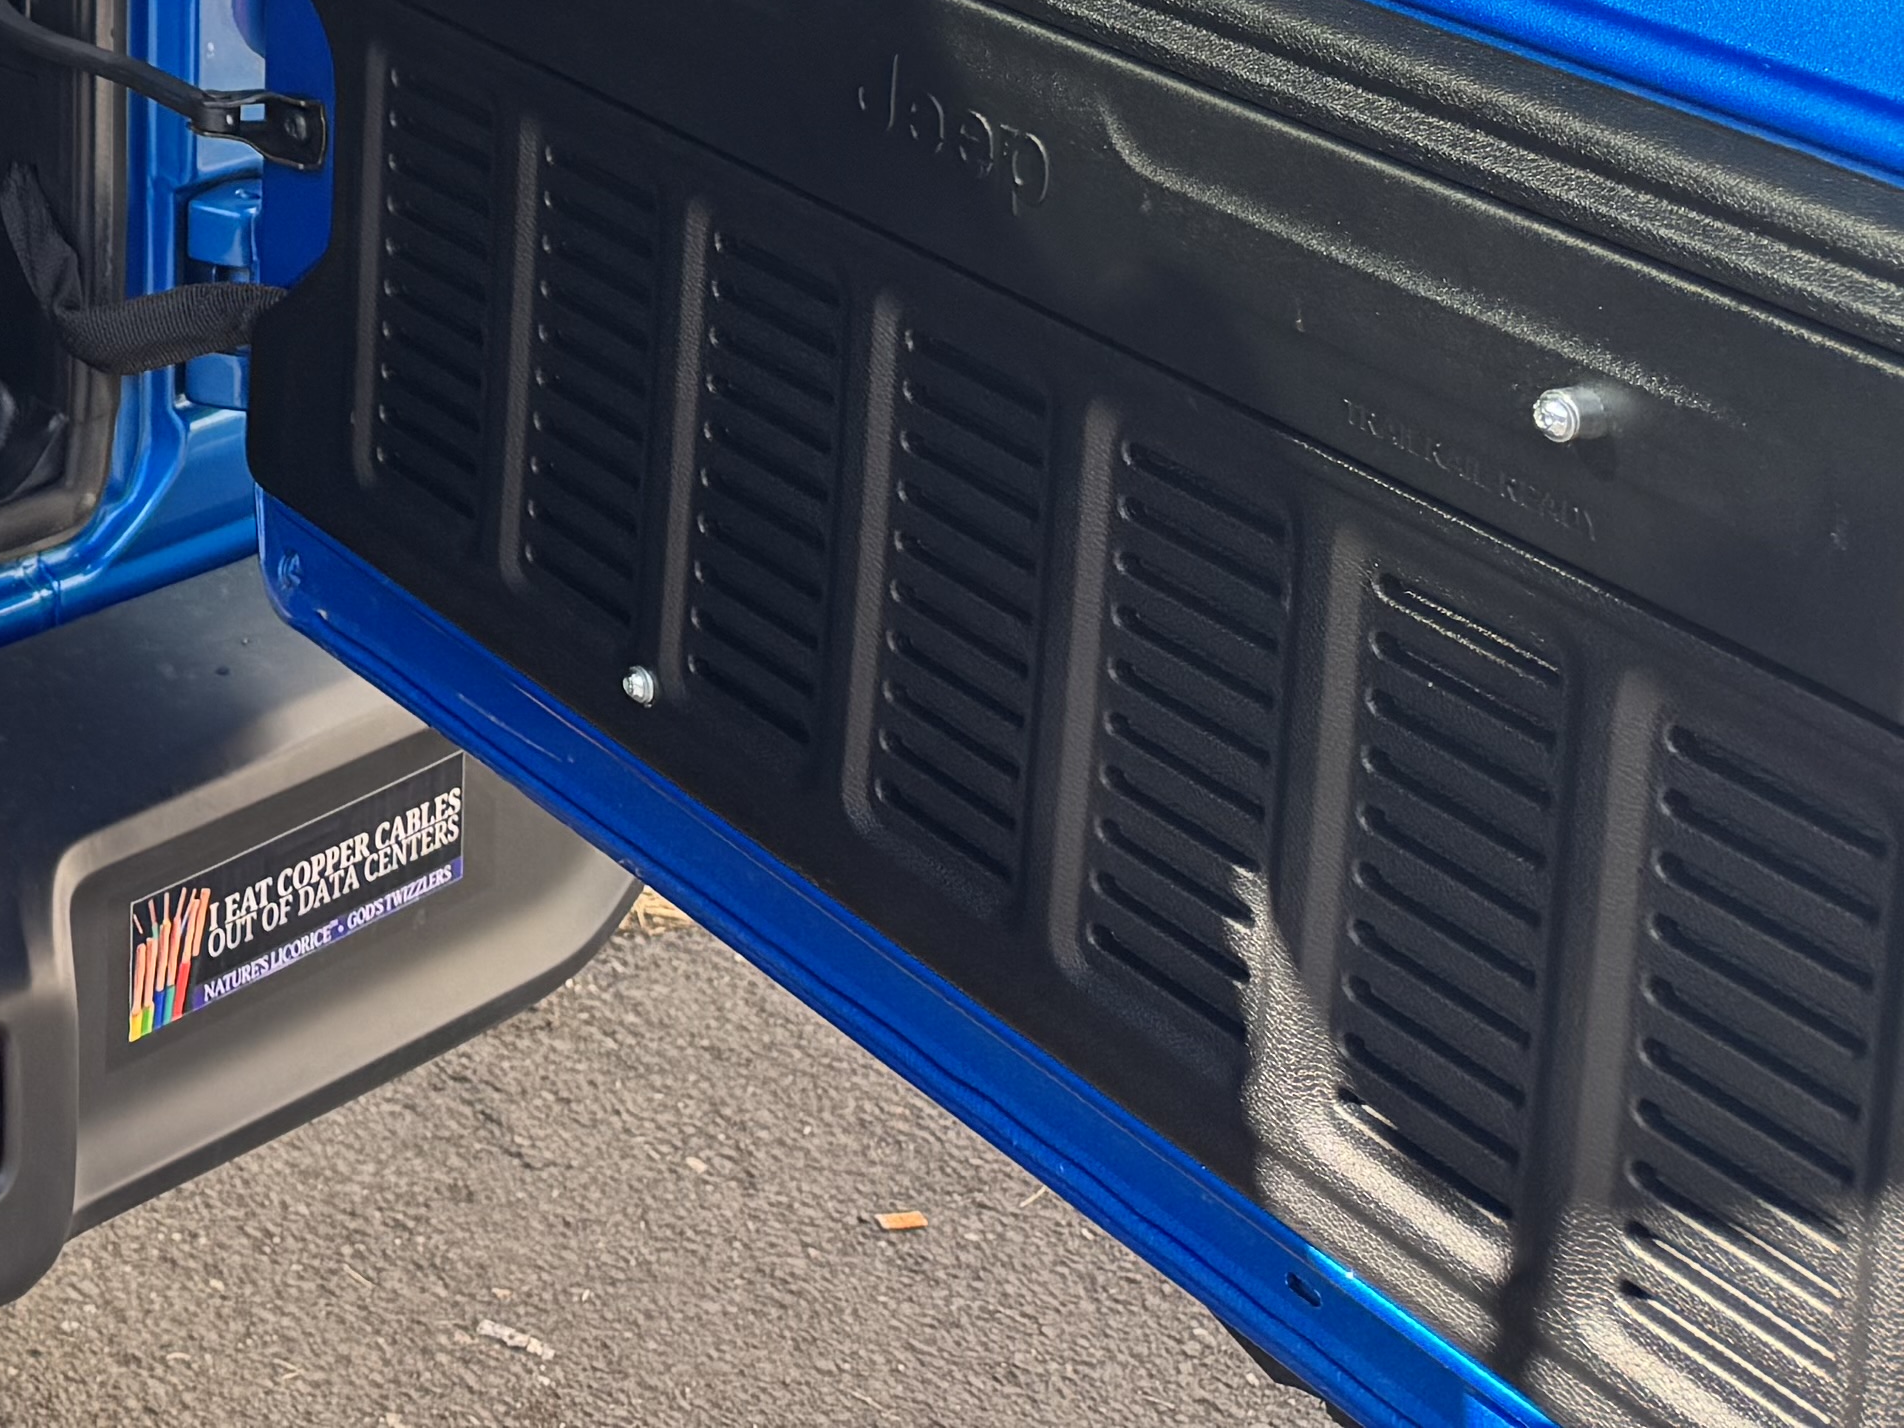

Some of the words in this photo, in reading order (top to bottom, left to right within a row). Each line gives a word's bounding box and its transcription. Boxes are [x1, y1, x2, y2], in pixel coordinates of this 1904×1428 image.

[208, 911, 257, 958] OUT
[262, 894, 293, 932] OF
[298, 865, 360, 916] DATA
[364, 814, 460, 882] CENTERS
[209, 902, 222, 931] I
[224, 877, 272, 923] EAT
[277, 832, 370, 897] COPPER
[375, 787, 461, 849] CABLES
[384, 864, 452, 911] TWIZZLERS
